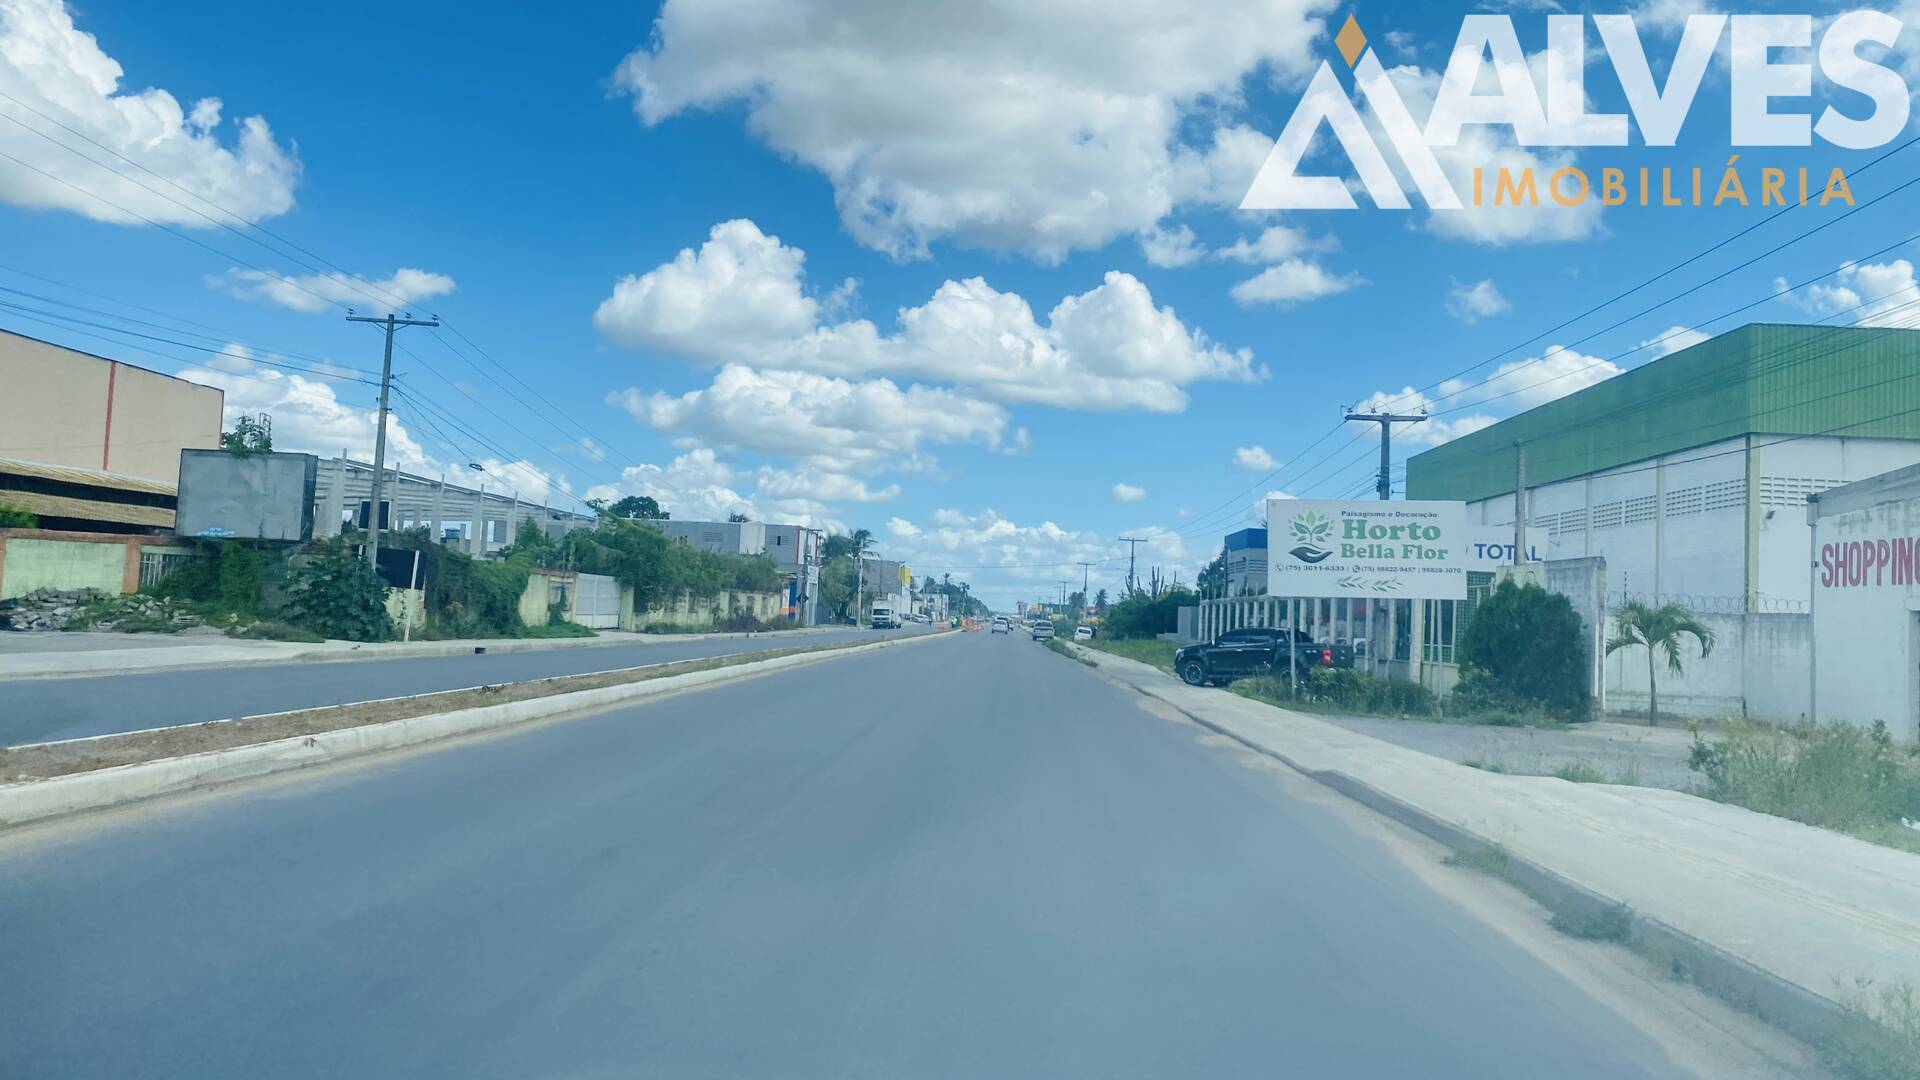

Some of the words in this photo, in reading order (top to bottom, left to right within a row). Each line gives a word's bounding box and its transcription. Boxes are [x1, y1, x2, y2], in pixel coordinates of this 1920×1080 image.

[1341, 510, 1386, 518] Paisagismo
[1342, 519, 1441, 541] Horto
[1341, 543, 1395, 559] Bella
[1401, 544, 1448, 560] Flor
[1474, 543, 1543, 561] TOTL
